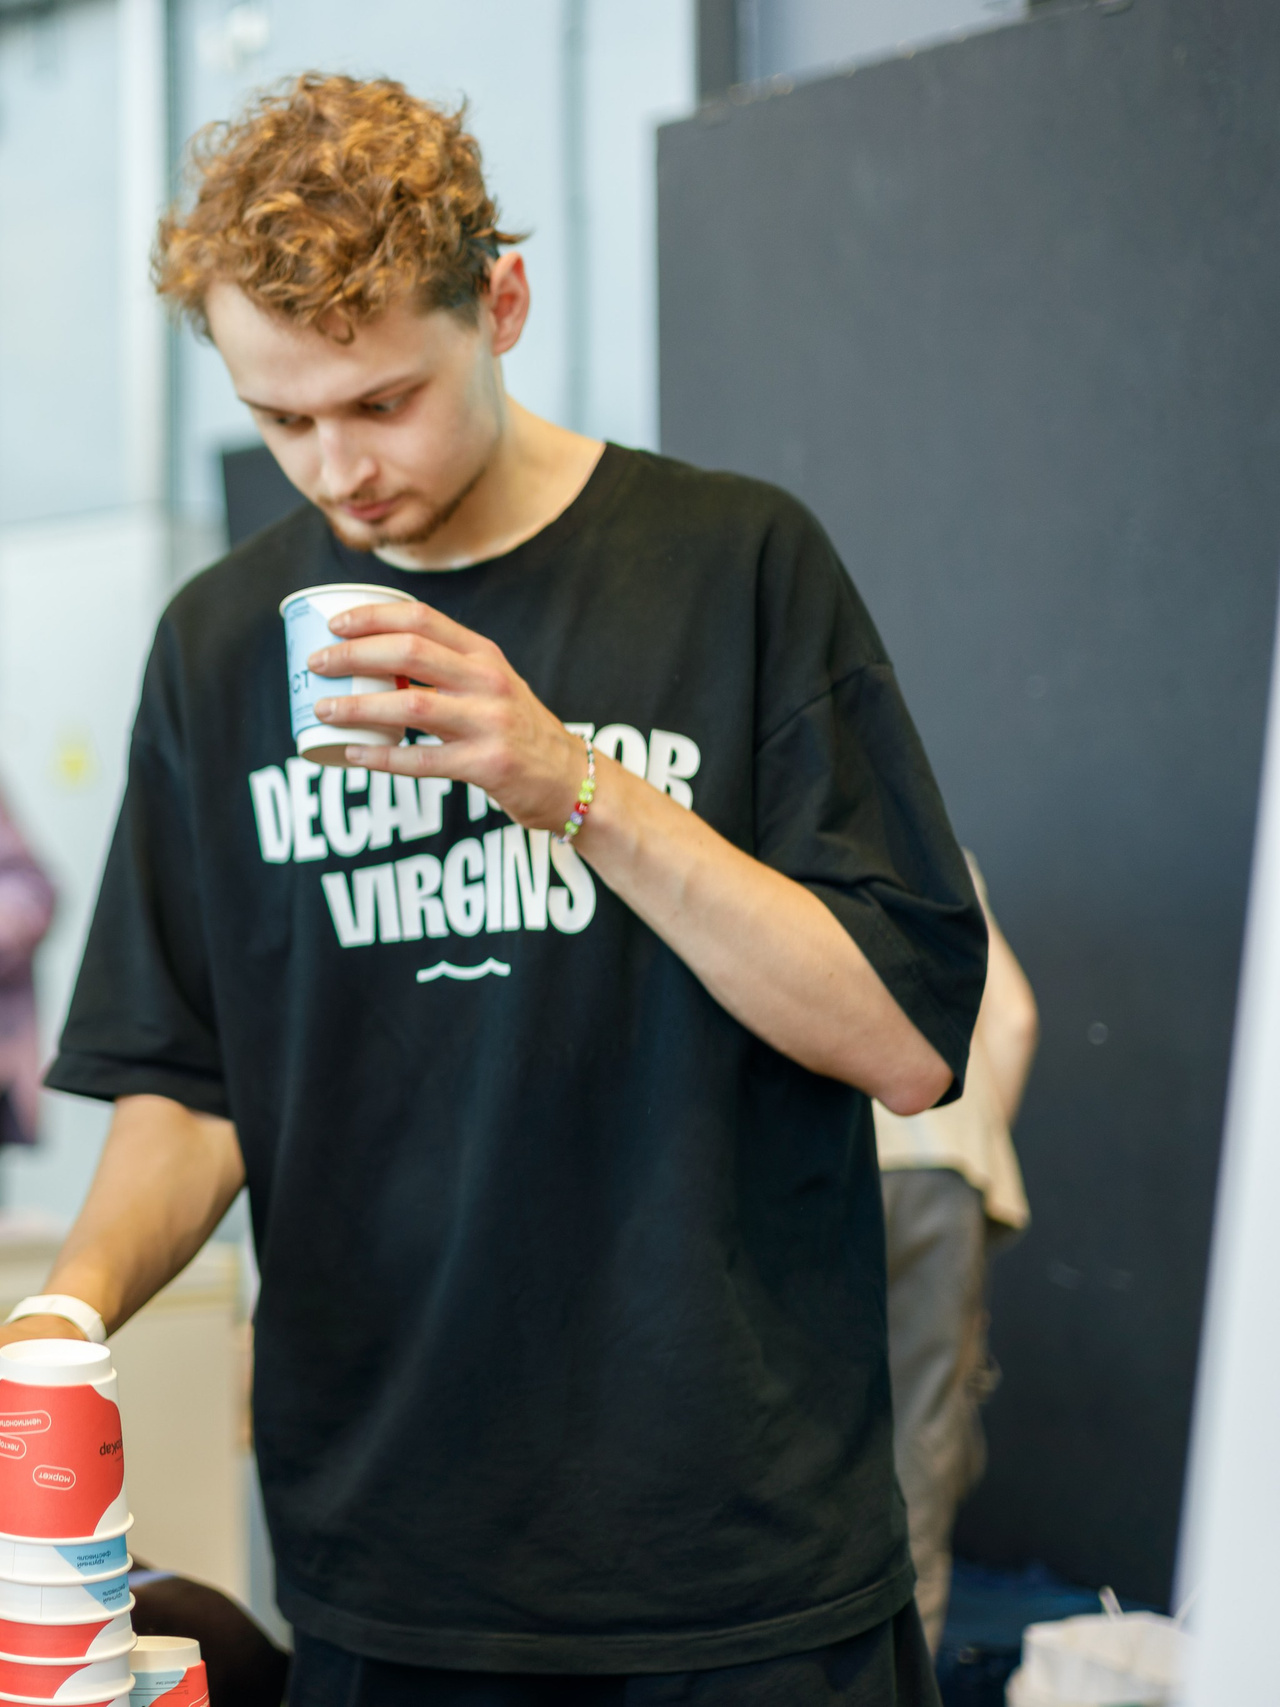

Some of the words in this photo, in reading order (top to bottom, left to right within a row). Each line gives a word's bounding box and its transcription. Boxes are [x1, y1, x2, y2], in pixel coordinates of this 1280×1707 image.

[562, 722, 701, 811] OR
[321, 824, 596, 948] VIRGINS
[0, 1417, 42, 1428] чемпионаты
[38, 1471, 71, 1484] маркет
